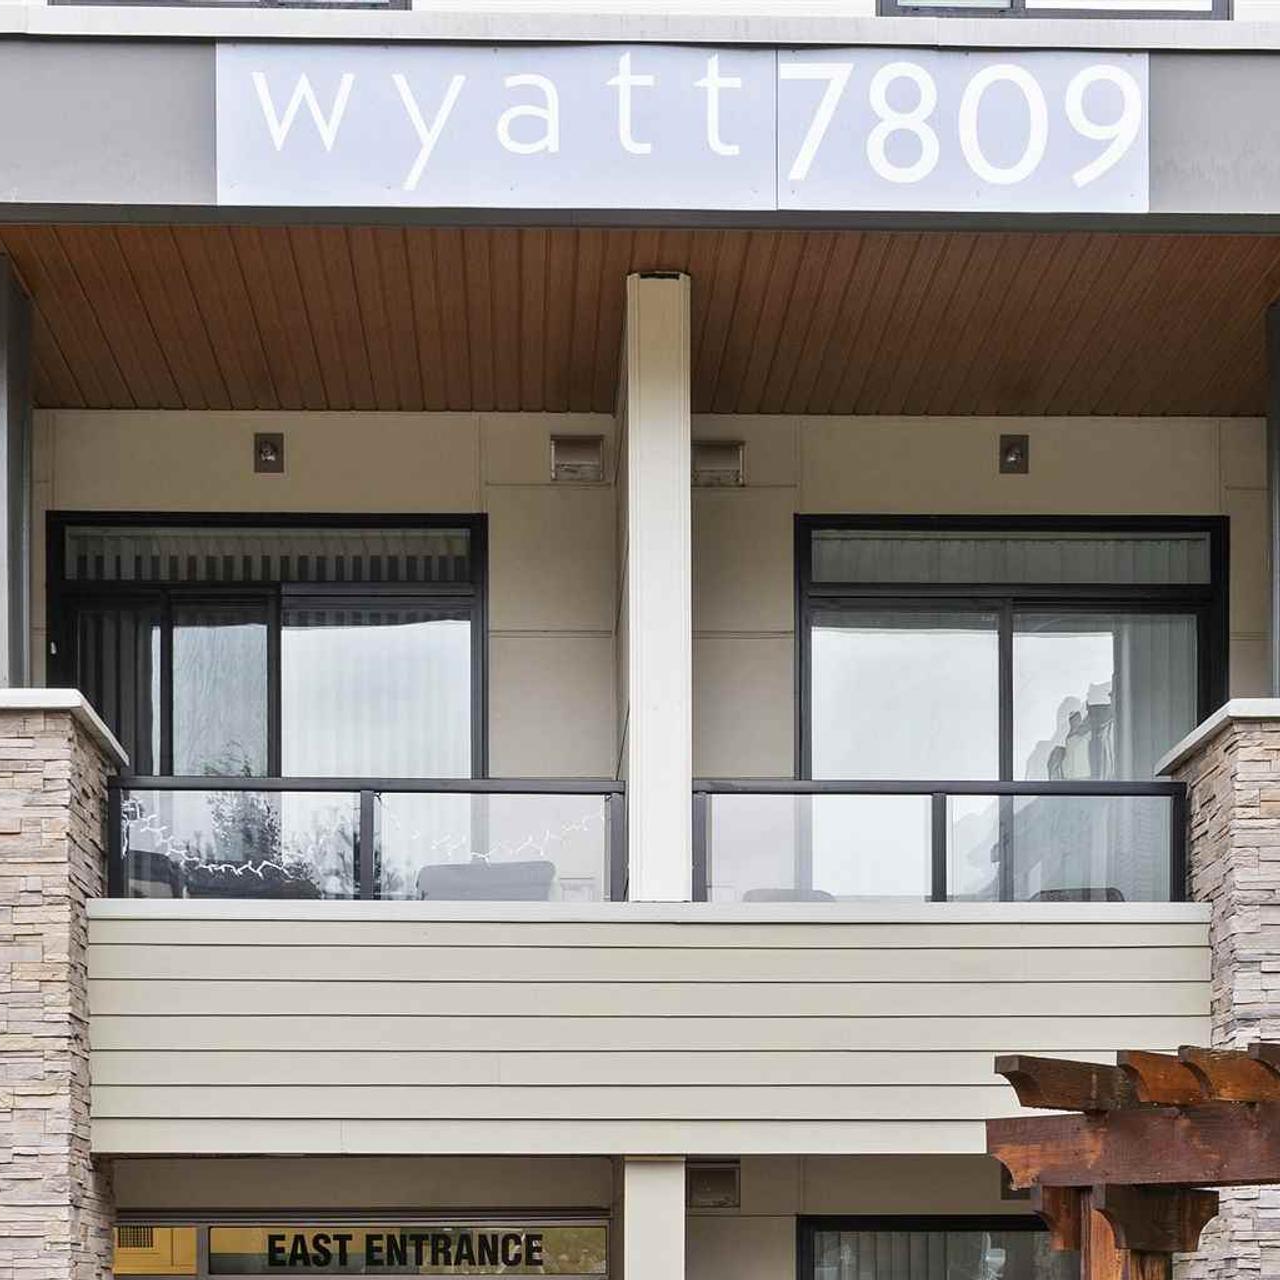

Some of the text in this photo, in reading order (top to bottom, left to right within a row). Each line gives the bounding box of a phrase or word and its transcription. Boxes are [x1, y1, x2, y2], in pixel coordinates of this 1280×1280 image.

[251, 52, 1143, 191] wyatt 7809
[267, 1233, 543, 1267] EAST ENTRANCE
